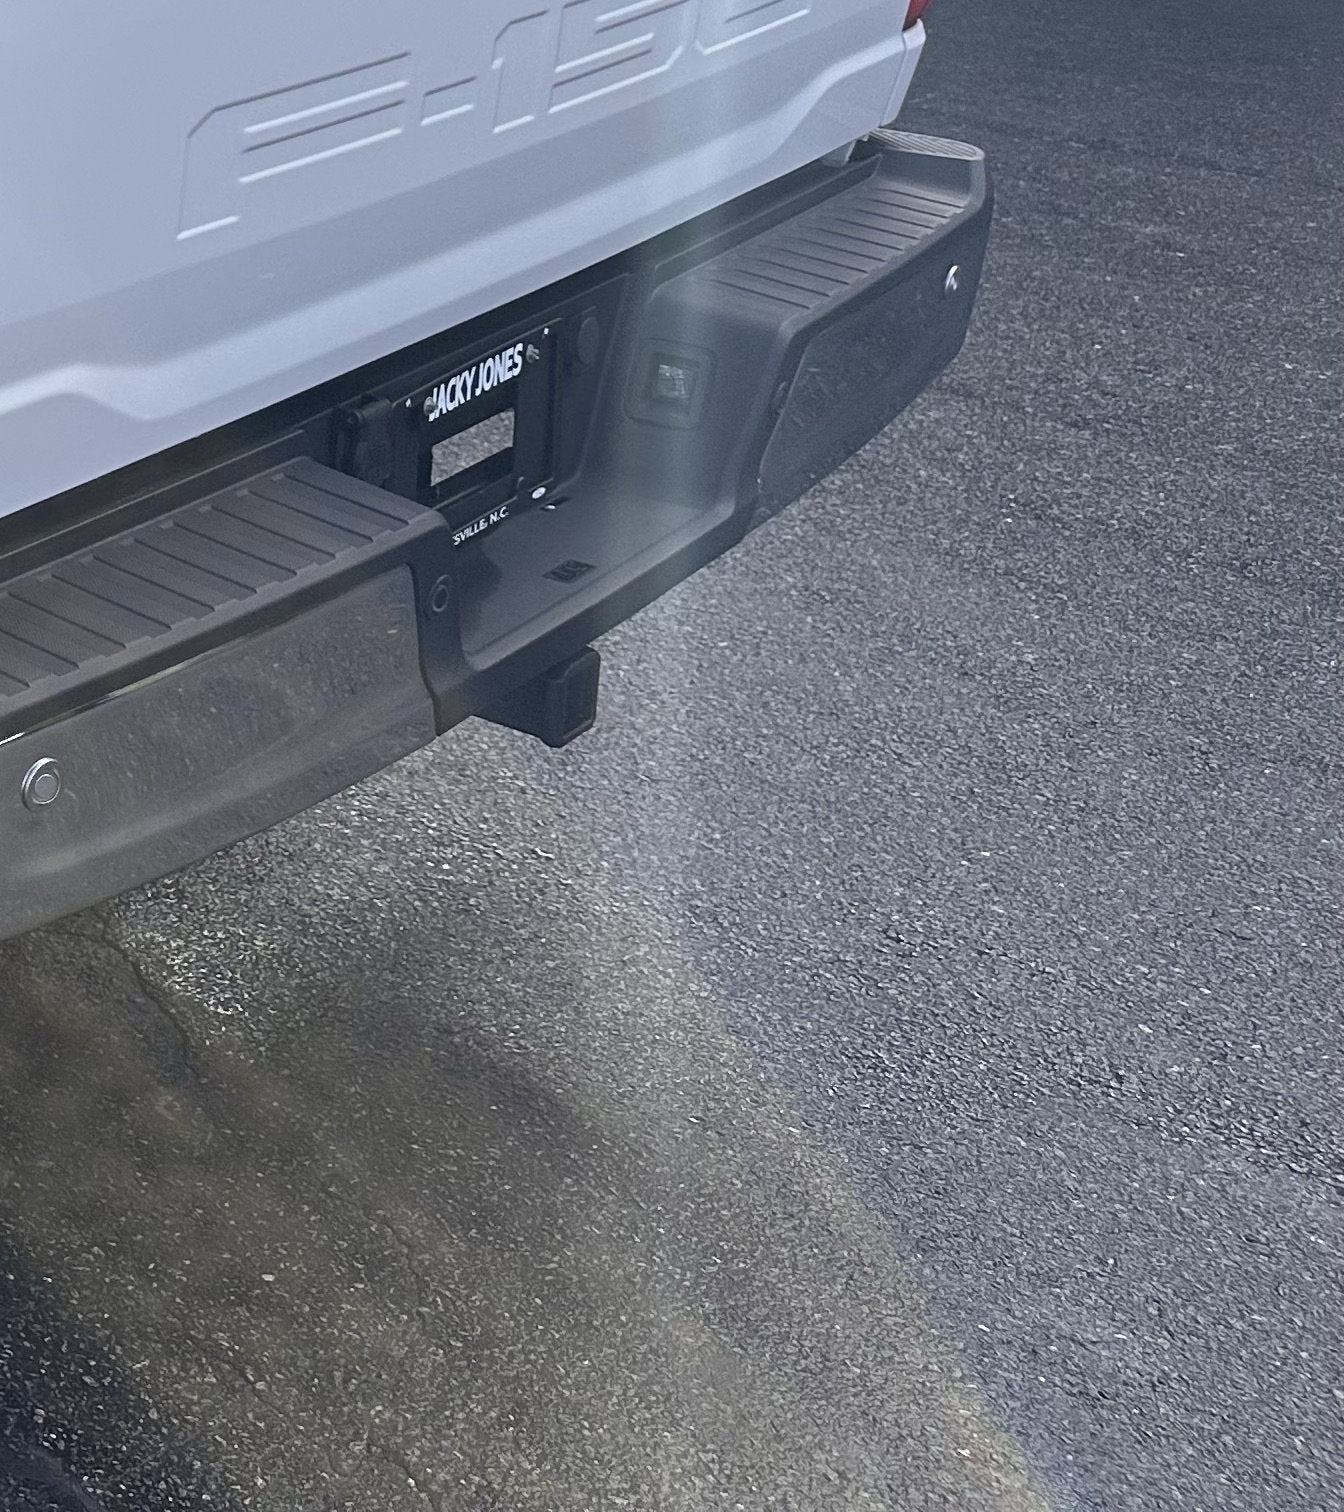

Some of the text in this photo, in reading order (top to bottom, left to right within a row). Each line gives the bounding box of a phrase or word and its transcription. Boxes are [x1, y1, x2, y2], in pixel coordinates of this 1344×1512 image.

[428, 343, 523, 422] JACKY JONES
[452, 518, 489, 546] SVILLE,
